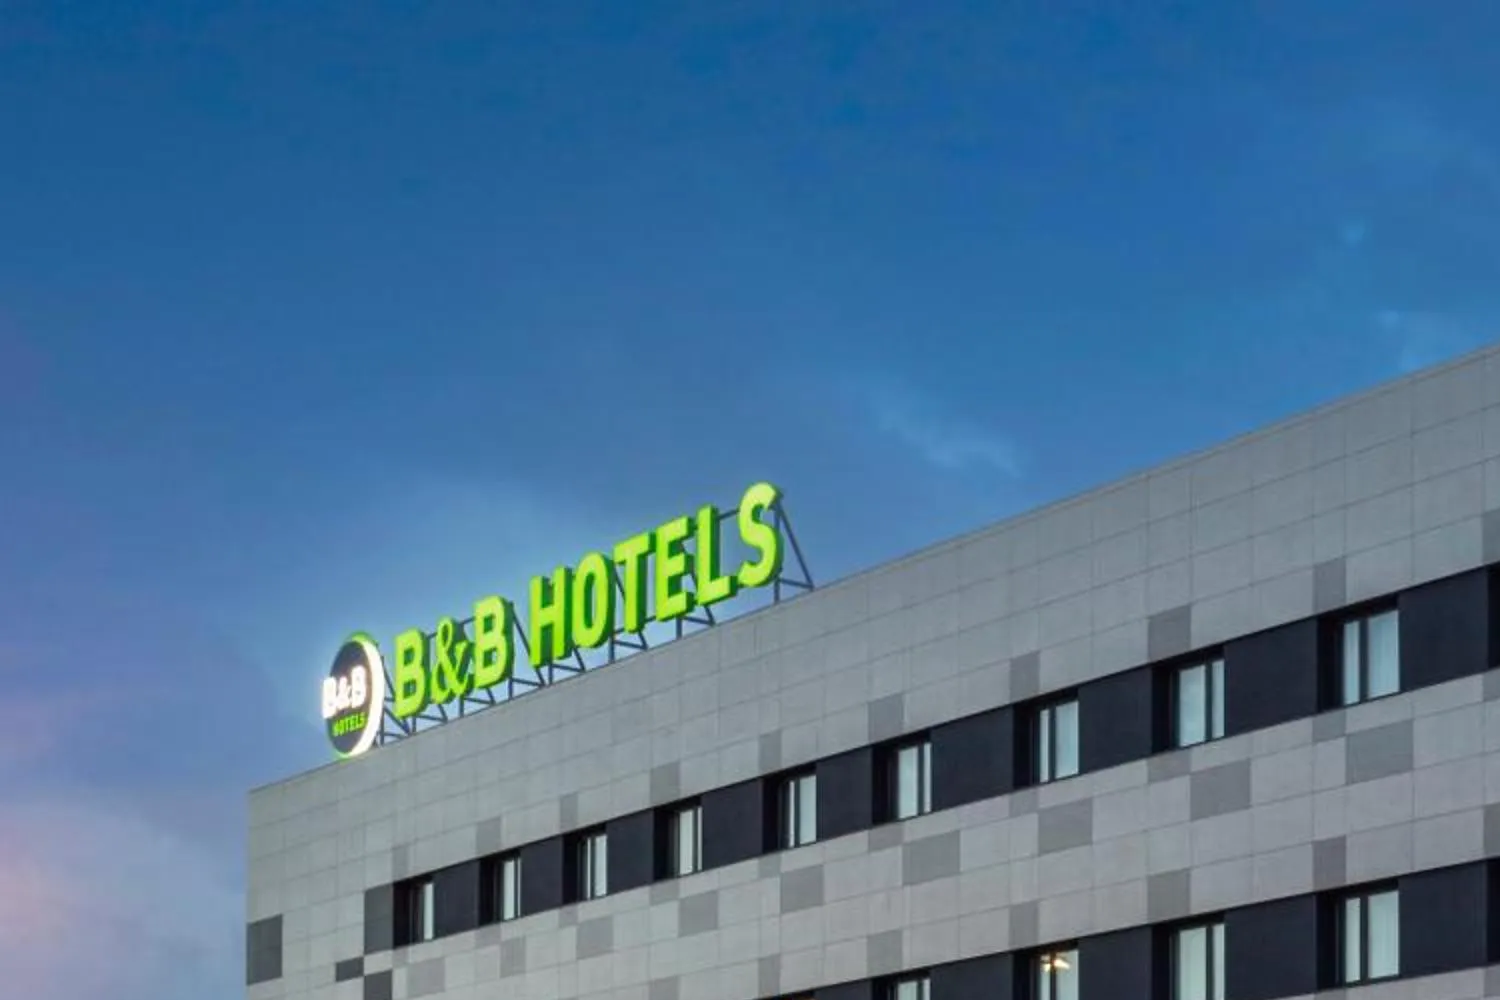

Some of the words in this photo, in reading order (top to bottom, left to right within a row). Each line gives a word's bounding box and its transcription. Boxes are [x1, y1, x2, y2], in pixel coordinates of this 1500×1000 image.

[394, 595, 513, 719] B&B
[529, 482, 783, 668] HOTELS
[322, 664, 366, 719] B&B
[332, 711, 366, 737] HOTELS
